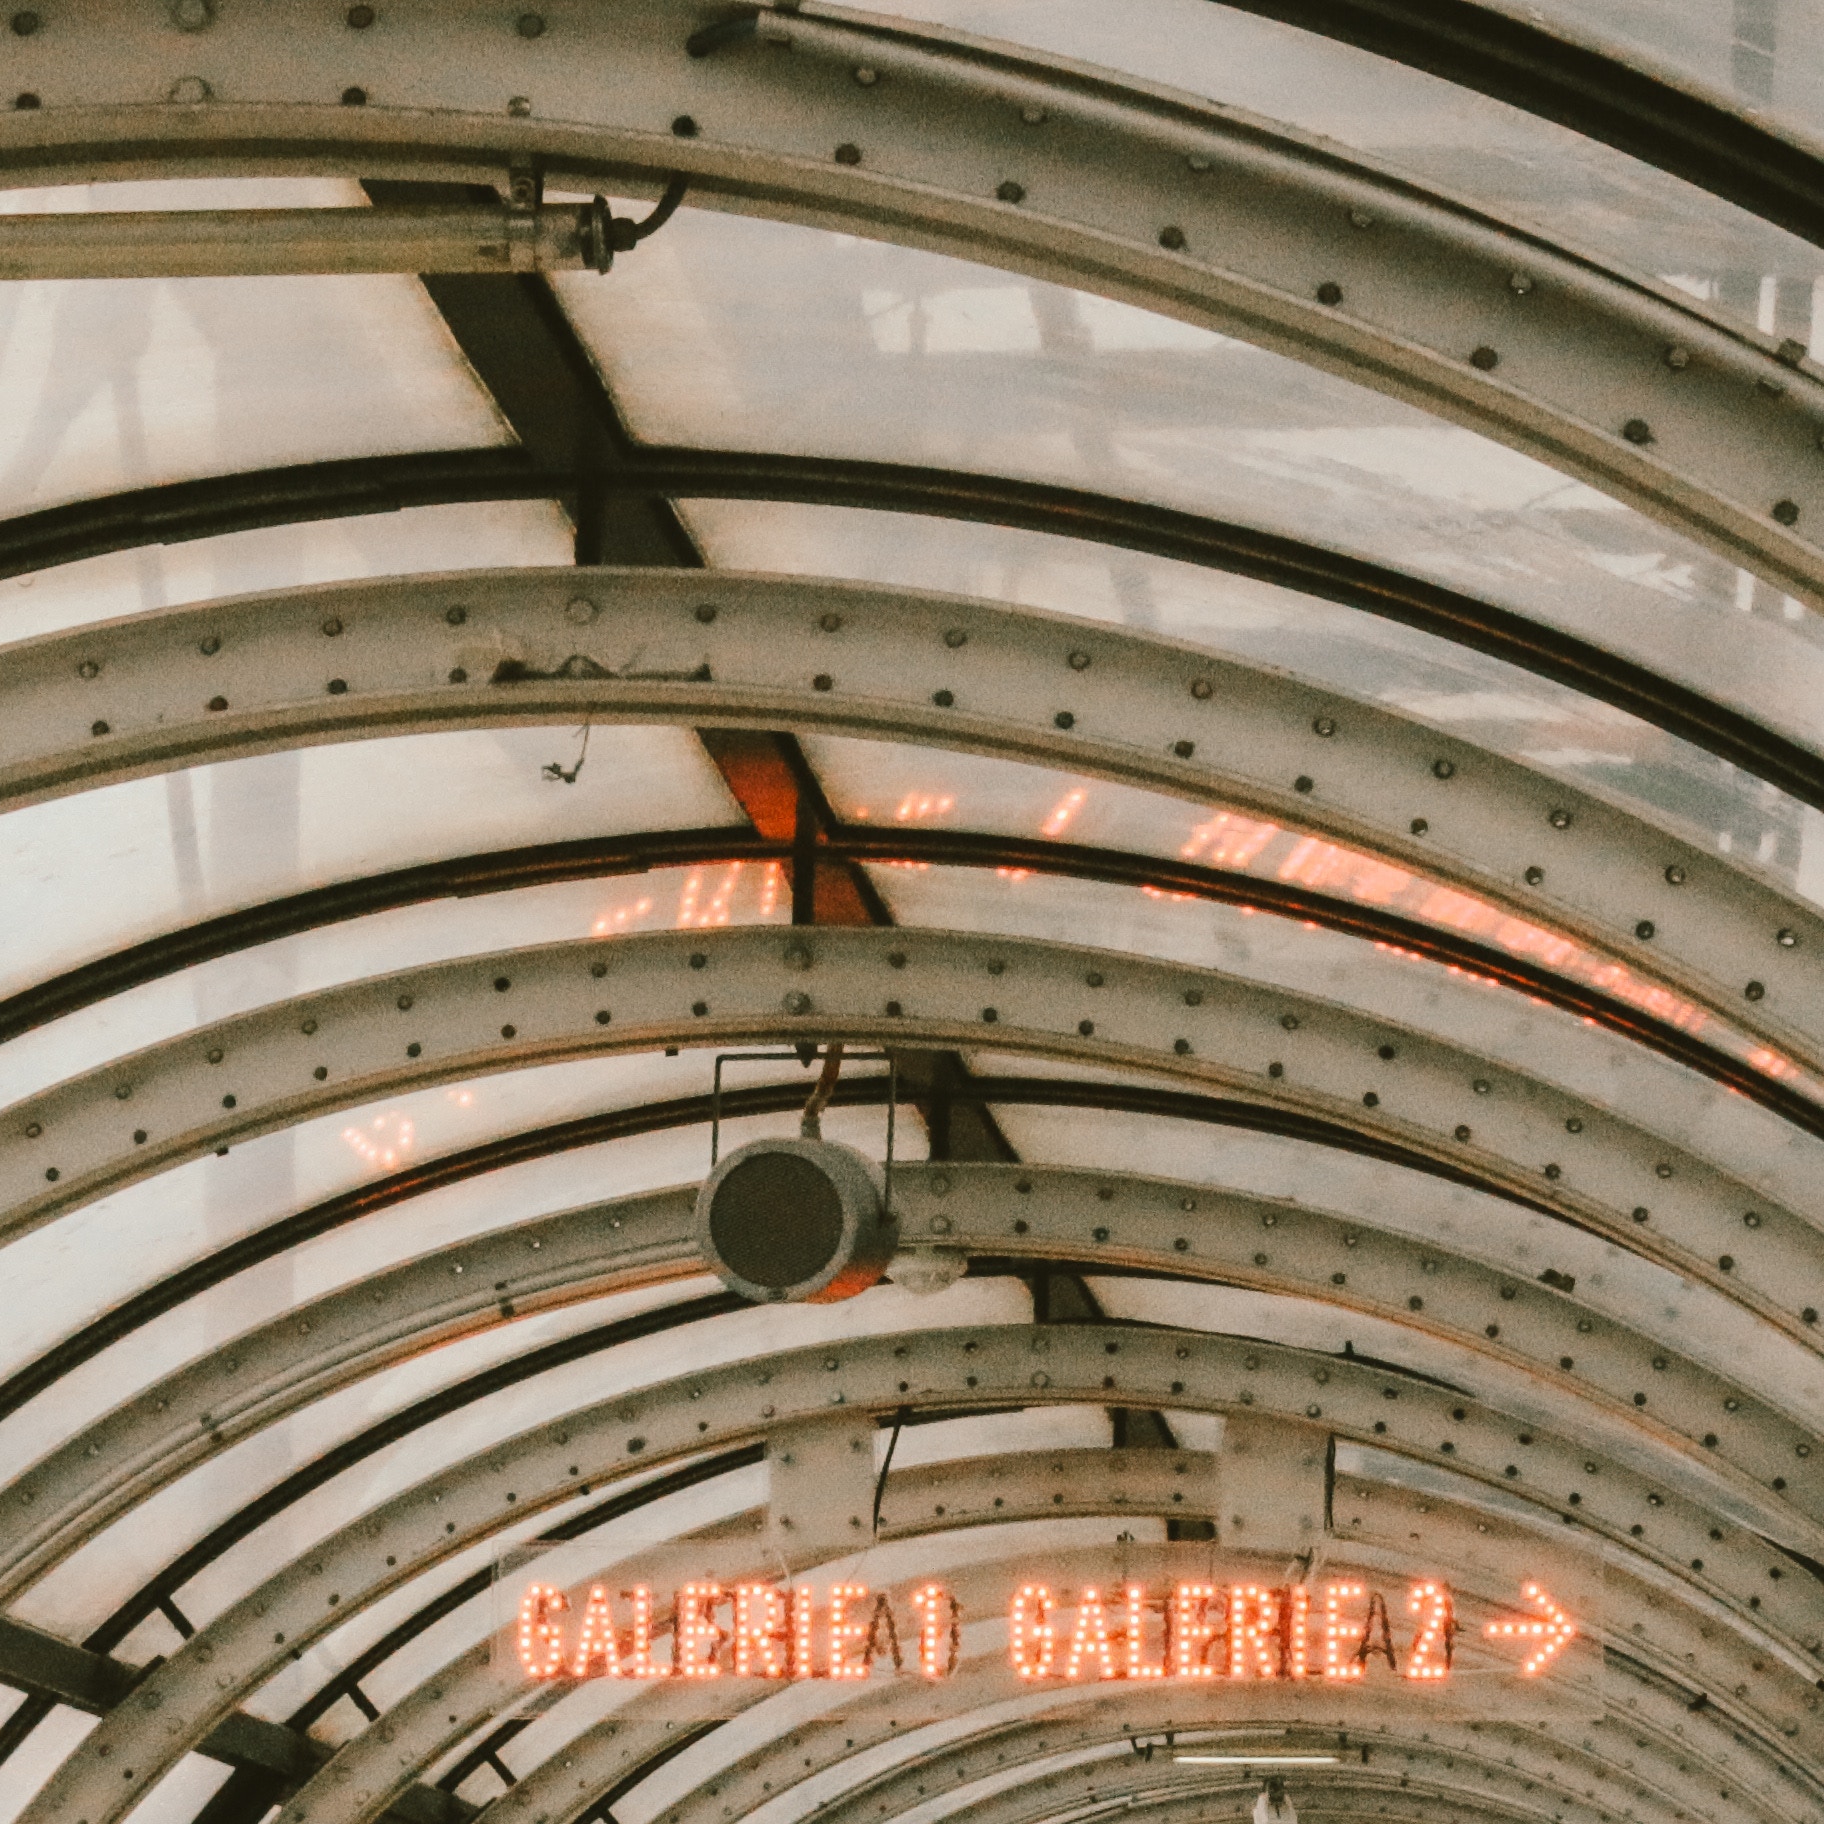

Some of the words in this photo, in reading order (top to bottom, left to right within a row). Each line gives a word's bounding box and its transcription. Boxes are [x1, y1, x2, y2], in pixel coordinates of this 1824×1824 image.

[516, 1583, 870, 1678] GALERIE
[910, 1583, 944, 1679] 1
[1010, 1583, 1368, 1679] GALERIE
[1406, 1582, 1448, 1680] 2
